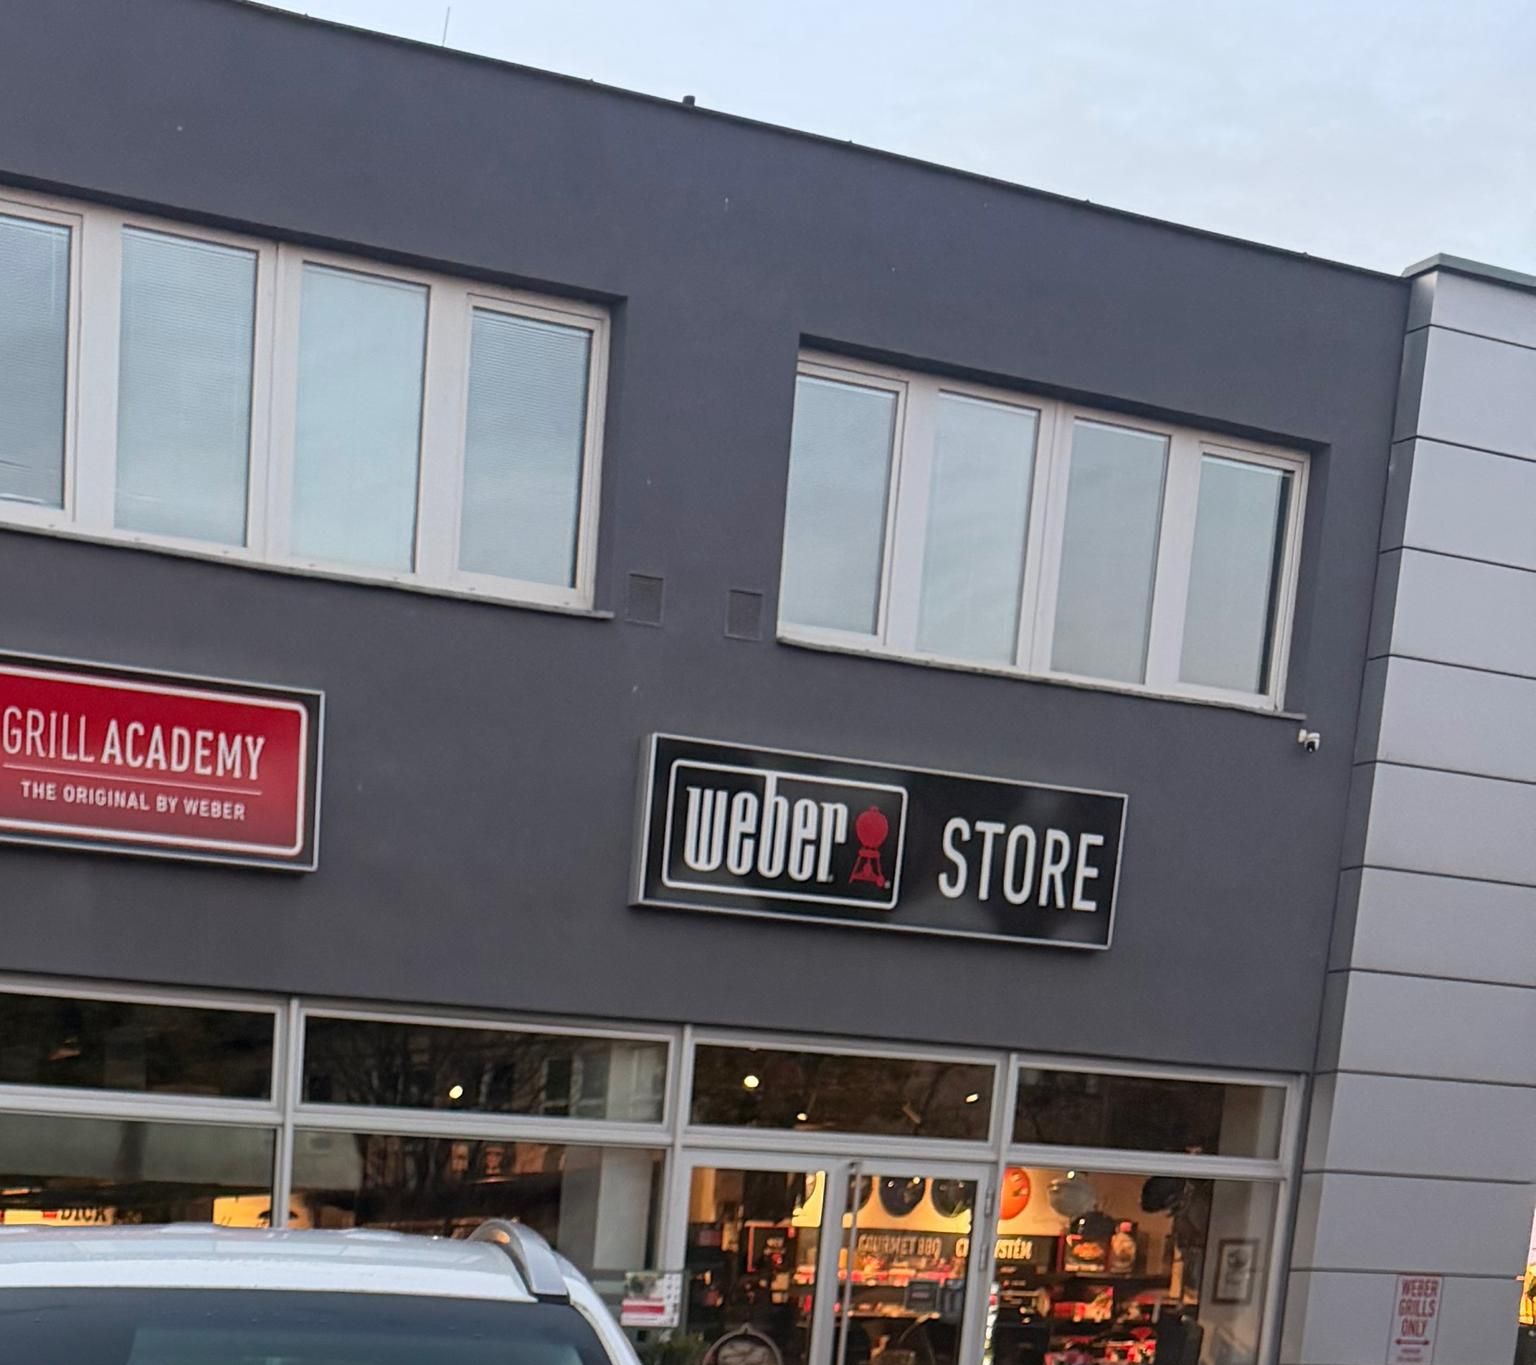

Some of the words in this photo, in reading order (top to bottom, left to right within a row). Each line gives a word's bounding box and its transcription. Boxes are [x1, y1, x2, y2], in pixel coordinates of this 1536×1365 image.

[2, 706, 95, 762] GRILL
[101, 719, 265, 780] ACADEMY
[21, 780, 57, 801] THE
[63, 784, 150, 811] ORIGINAL
[156, 794, 178, 814] BY
[184, 798, 246, 821] WEBER
[684, 776, 848, 883] weber
[938, 817, 1104, 912] STORE
[1402, 1279, 1439, 1297] WEBER
[1398, 1298, 1437, 1317] GRILLS
[1401, 1318, 1429, 1337] ONLY
